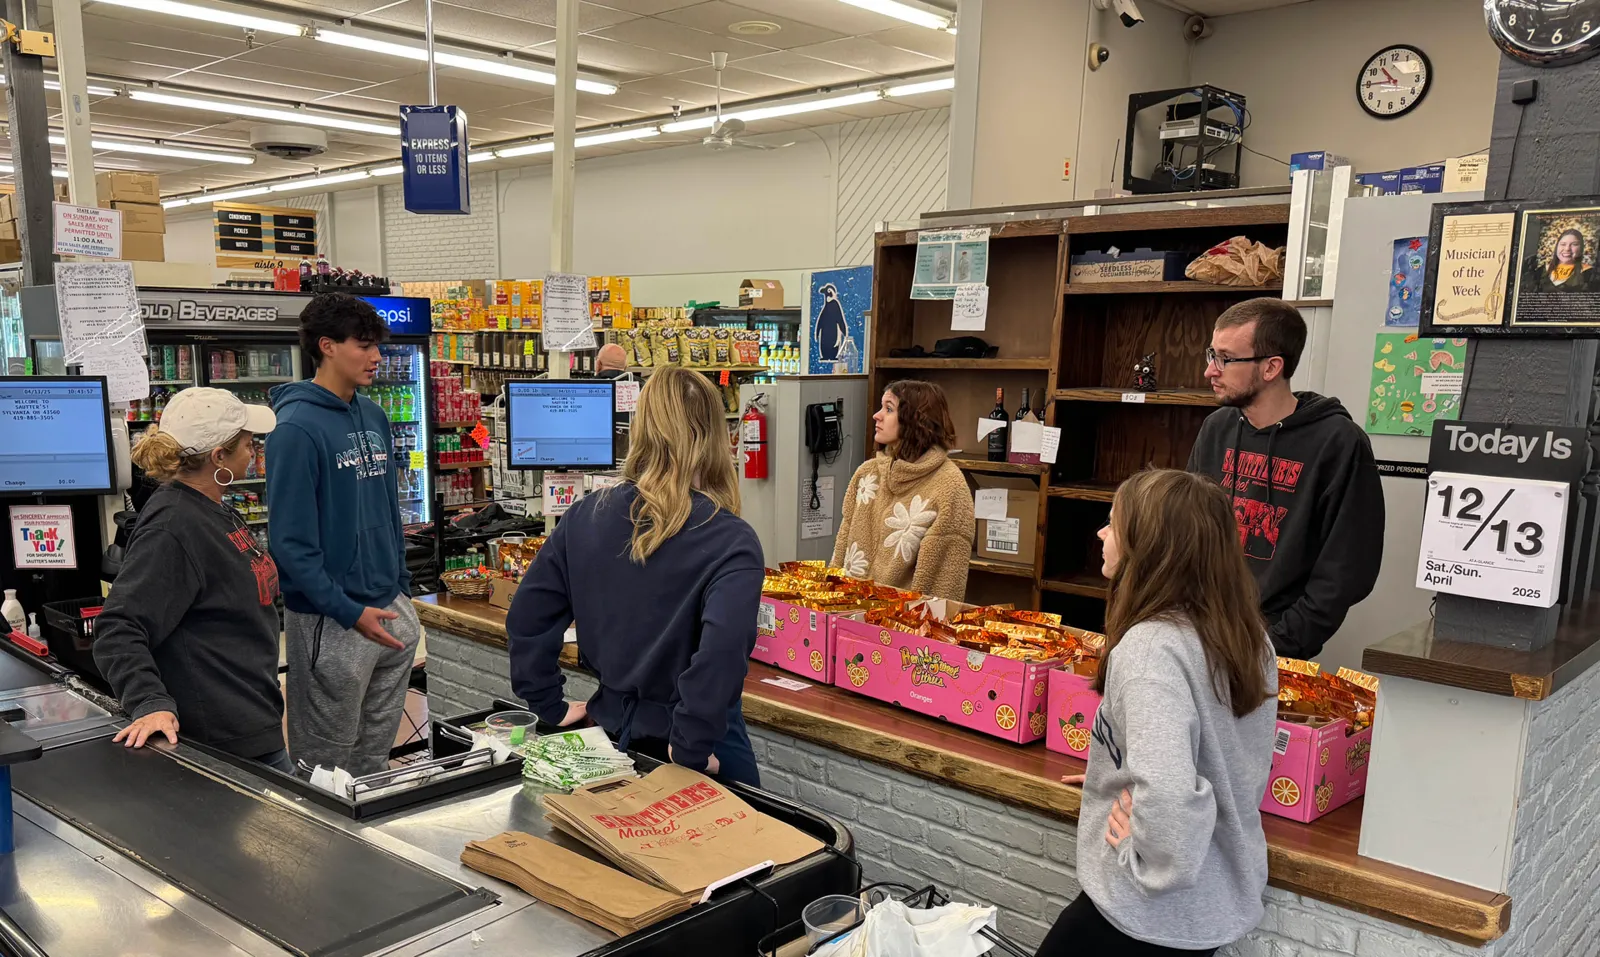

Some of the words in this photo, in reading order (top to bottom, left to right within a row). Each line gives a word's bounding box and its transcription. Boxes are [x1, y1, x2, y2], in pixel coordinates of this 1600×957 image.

[1508, 14, 1516, 26] 8
[1581, 21, 1590, 33] 5
[1526, 29, 1535, 40] 7
[1551, 28, 1562, 44] 6
[1379, 58, 1386, 66] 11
[1391, 52, 1400, 62] 12
[1369, 68, 1378, 76] 10
[1415, 74, 1420, 82] 3
[1368, 92, 1373, 100] 8
[1400, 96, 1406, 105] 5
[1377, 100, 1381, 108] 7
[1388, 102, 1393, 110] 6
[411, 138, 450, 150] EXPRESS
[415, 154, 423, 163] 10
[425, 154, 448, 163] ITEMS
[417, 164, 426, 174] OR
[429, 164, 446, 174] LESS
[64, 228, 95, 236] PERMITTED
[1445, 248, 1496, 260] Musician
[255, 260, 275, 269] aisle
[1452, 267, 1464, 278] of
[1466, 267, 1484, 278] the
[1452, 285, 1481, 297] Week
[142, 303, 172, 320] OLD
[178, 300, 278, 322] BEVERAGES
[377, 306, 410, 326] epsi
[1444, 425, 1539, 464] Today
[1542, 431, 1572, 460] Is
[1396, 465, 1428, 474] PERSONNEL
[1425, 560, 1481, 578] Sat./Sun.
[1424, 573, 1452, 586] April
[1512, 587, 1541, 599] 2025
[910, 690, 933, 704] Oranges
[591, 782, 722, 830] SAUTTER'S
[618, 820, 680, 840] Market
